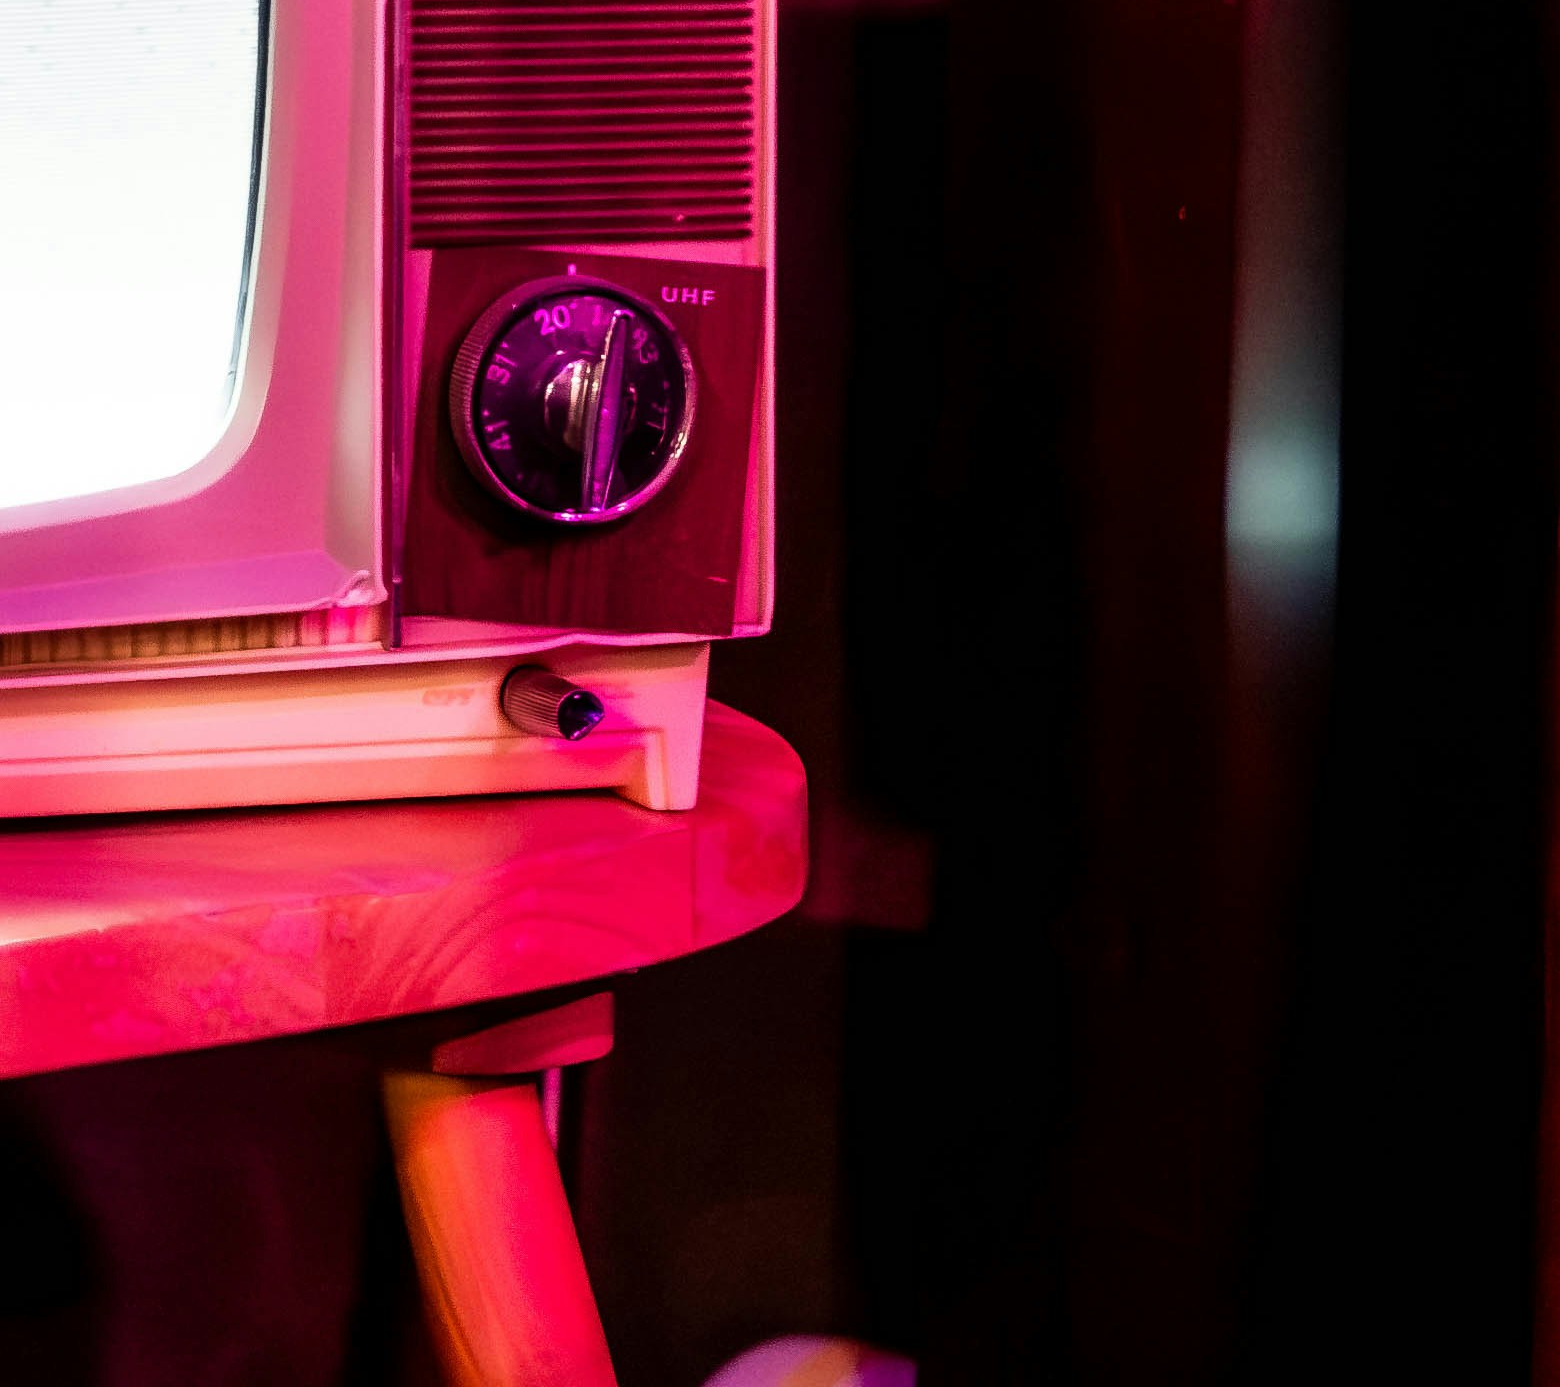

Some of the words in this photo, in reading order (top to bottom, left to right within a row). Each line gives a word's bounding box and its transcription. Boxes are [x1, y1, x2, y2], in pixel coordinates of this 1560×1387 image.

[661, 287, 715, 306] UHF
[533, 305, 571, 336] 20
[487, 354, 518, 385] 31
